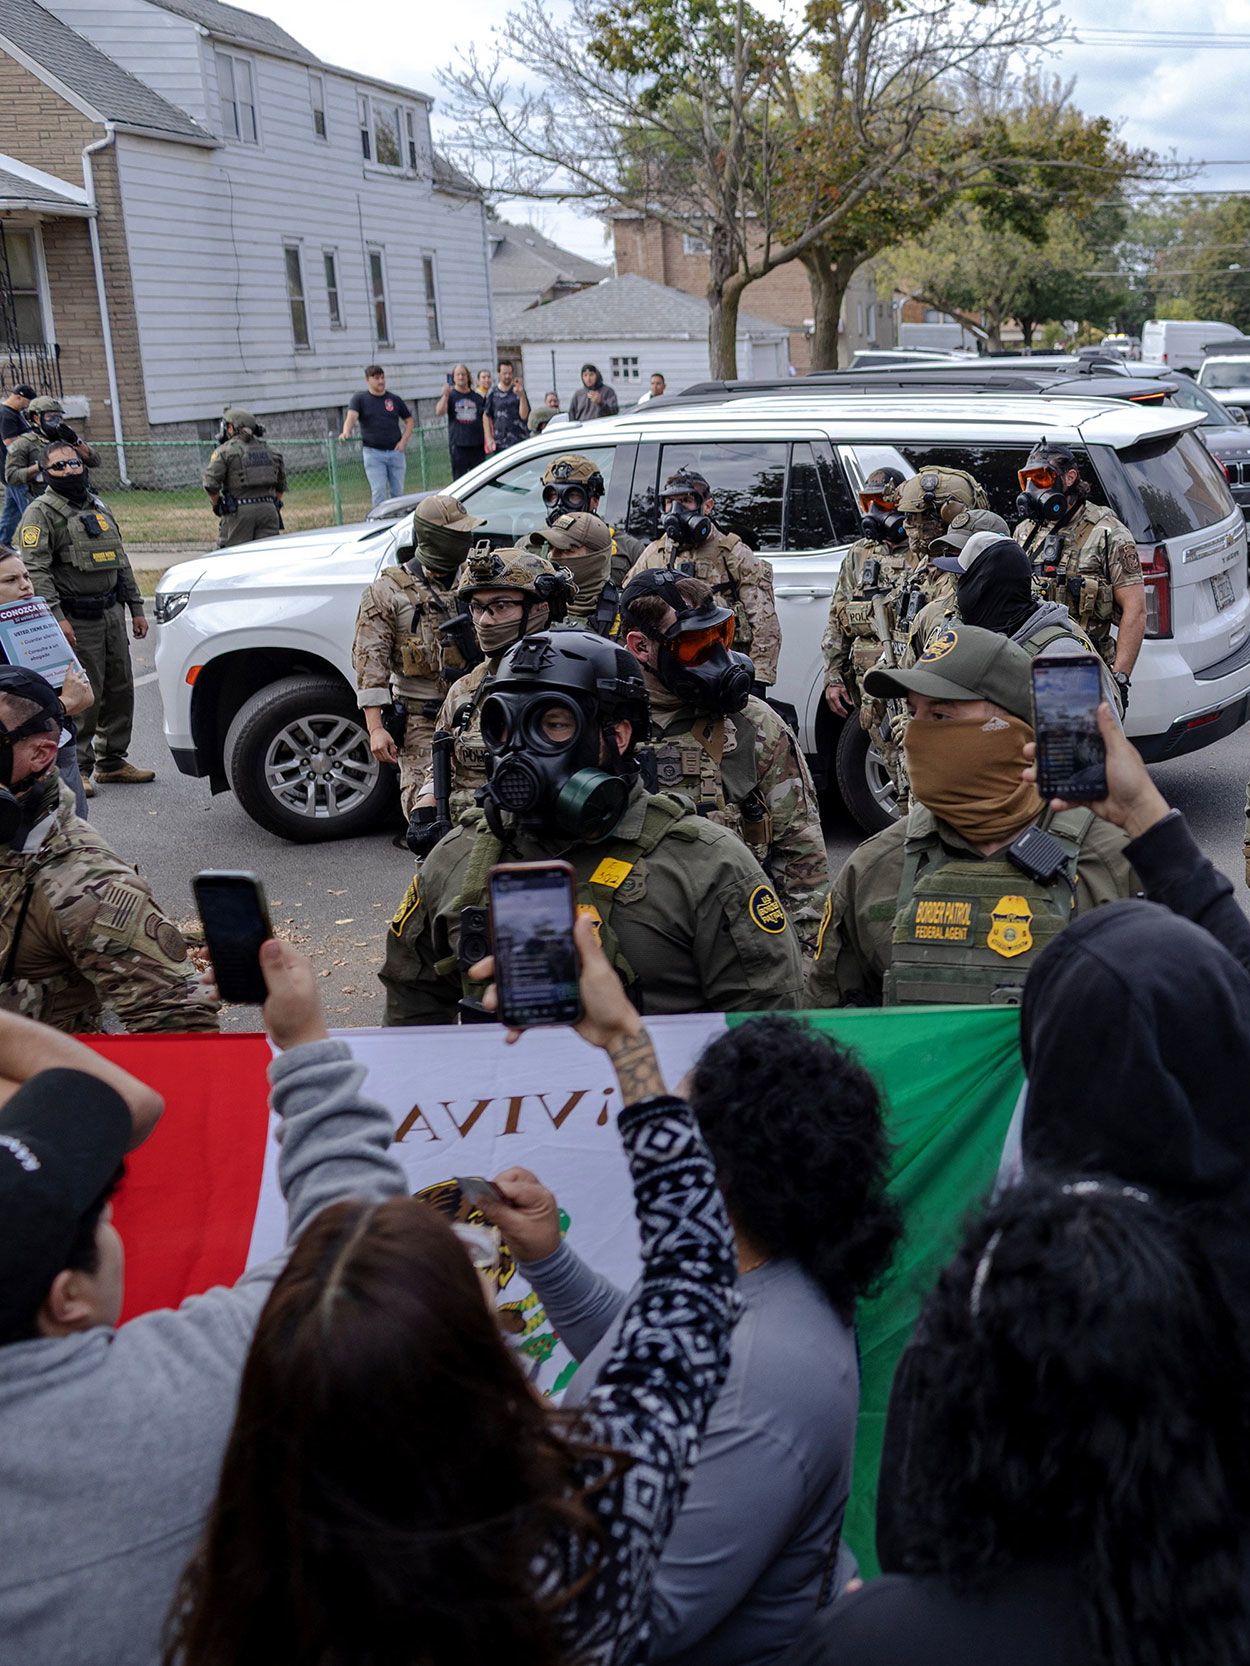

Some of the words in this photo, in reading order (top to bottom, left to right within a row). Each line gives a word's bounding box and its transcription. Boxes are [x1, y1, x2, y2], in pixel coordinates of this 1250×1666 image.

[0, 604, 38, 619] CONOZCA
[915, 901, 946, 924] BORDER
[945, 902, 972, 925] PATROL
[915, 925, 944, 939] FEDERAL
[945, 927, 968, 940] AGENT
